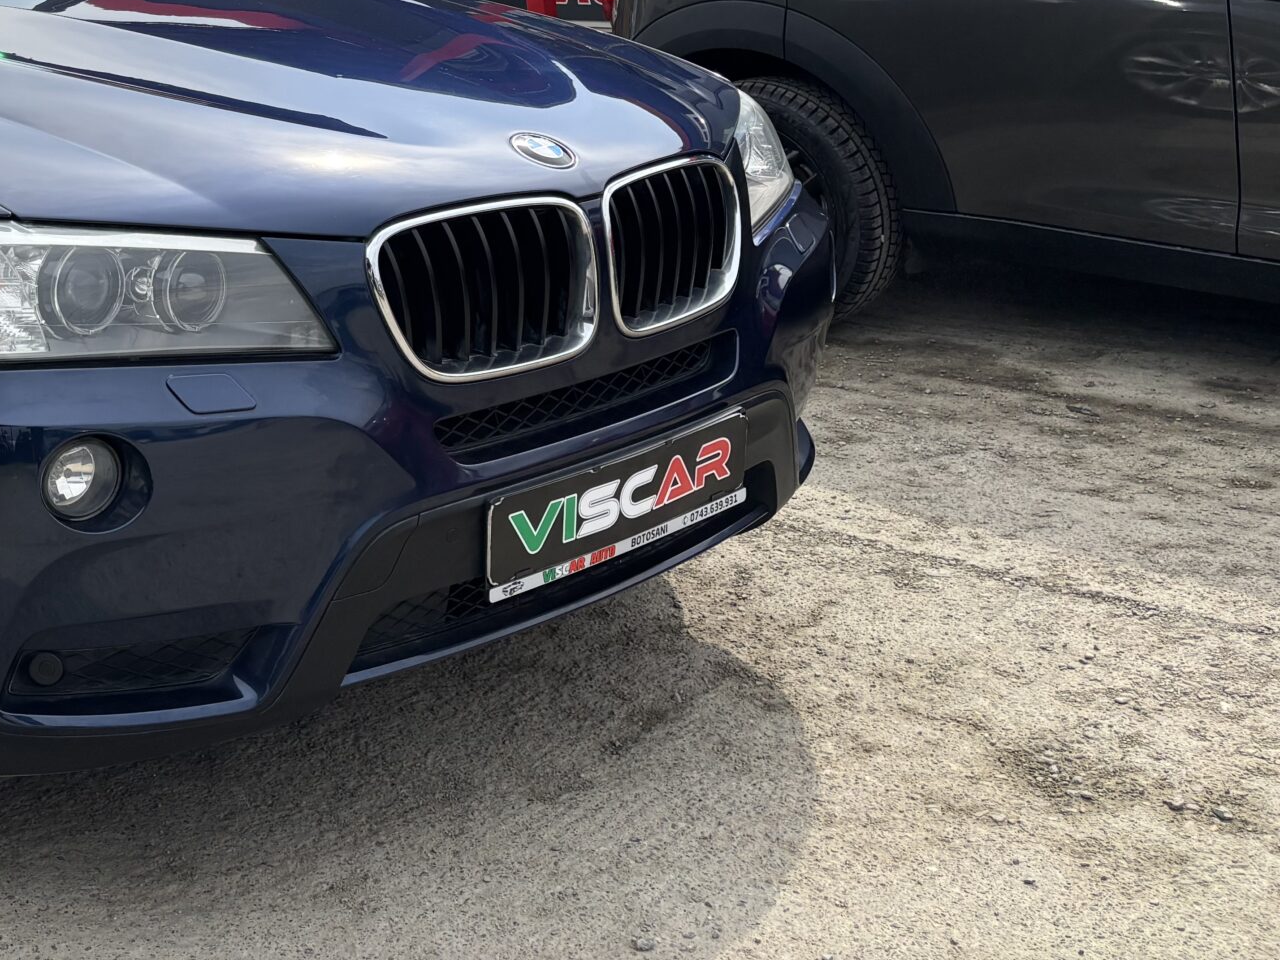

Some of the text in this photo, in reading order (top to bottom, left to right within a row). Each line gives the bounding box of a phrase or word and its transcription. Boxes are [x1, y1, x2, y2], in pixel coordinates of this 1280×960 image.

[508, 437, 732, 555] VISCAR
[543, 493, 738, 583] VISCAR AUTO BOTOSANI 0743.639.931
